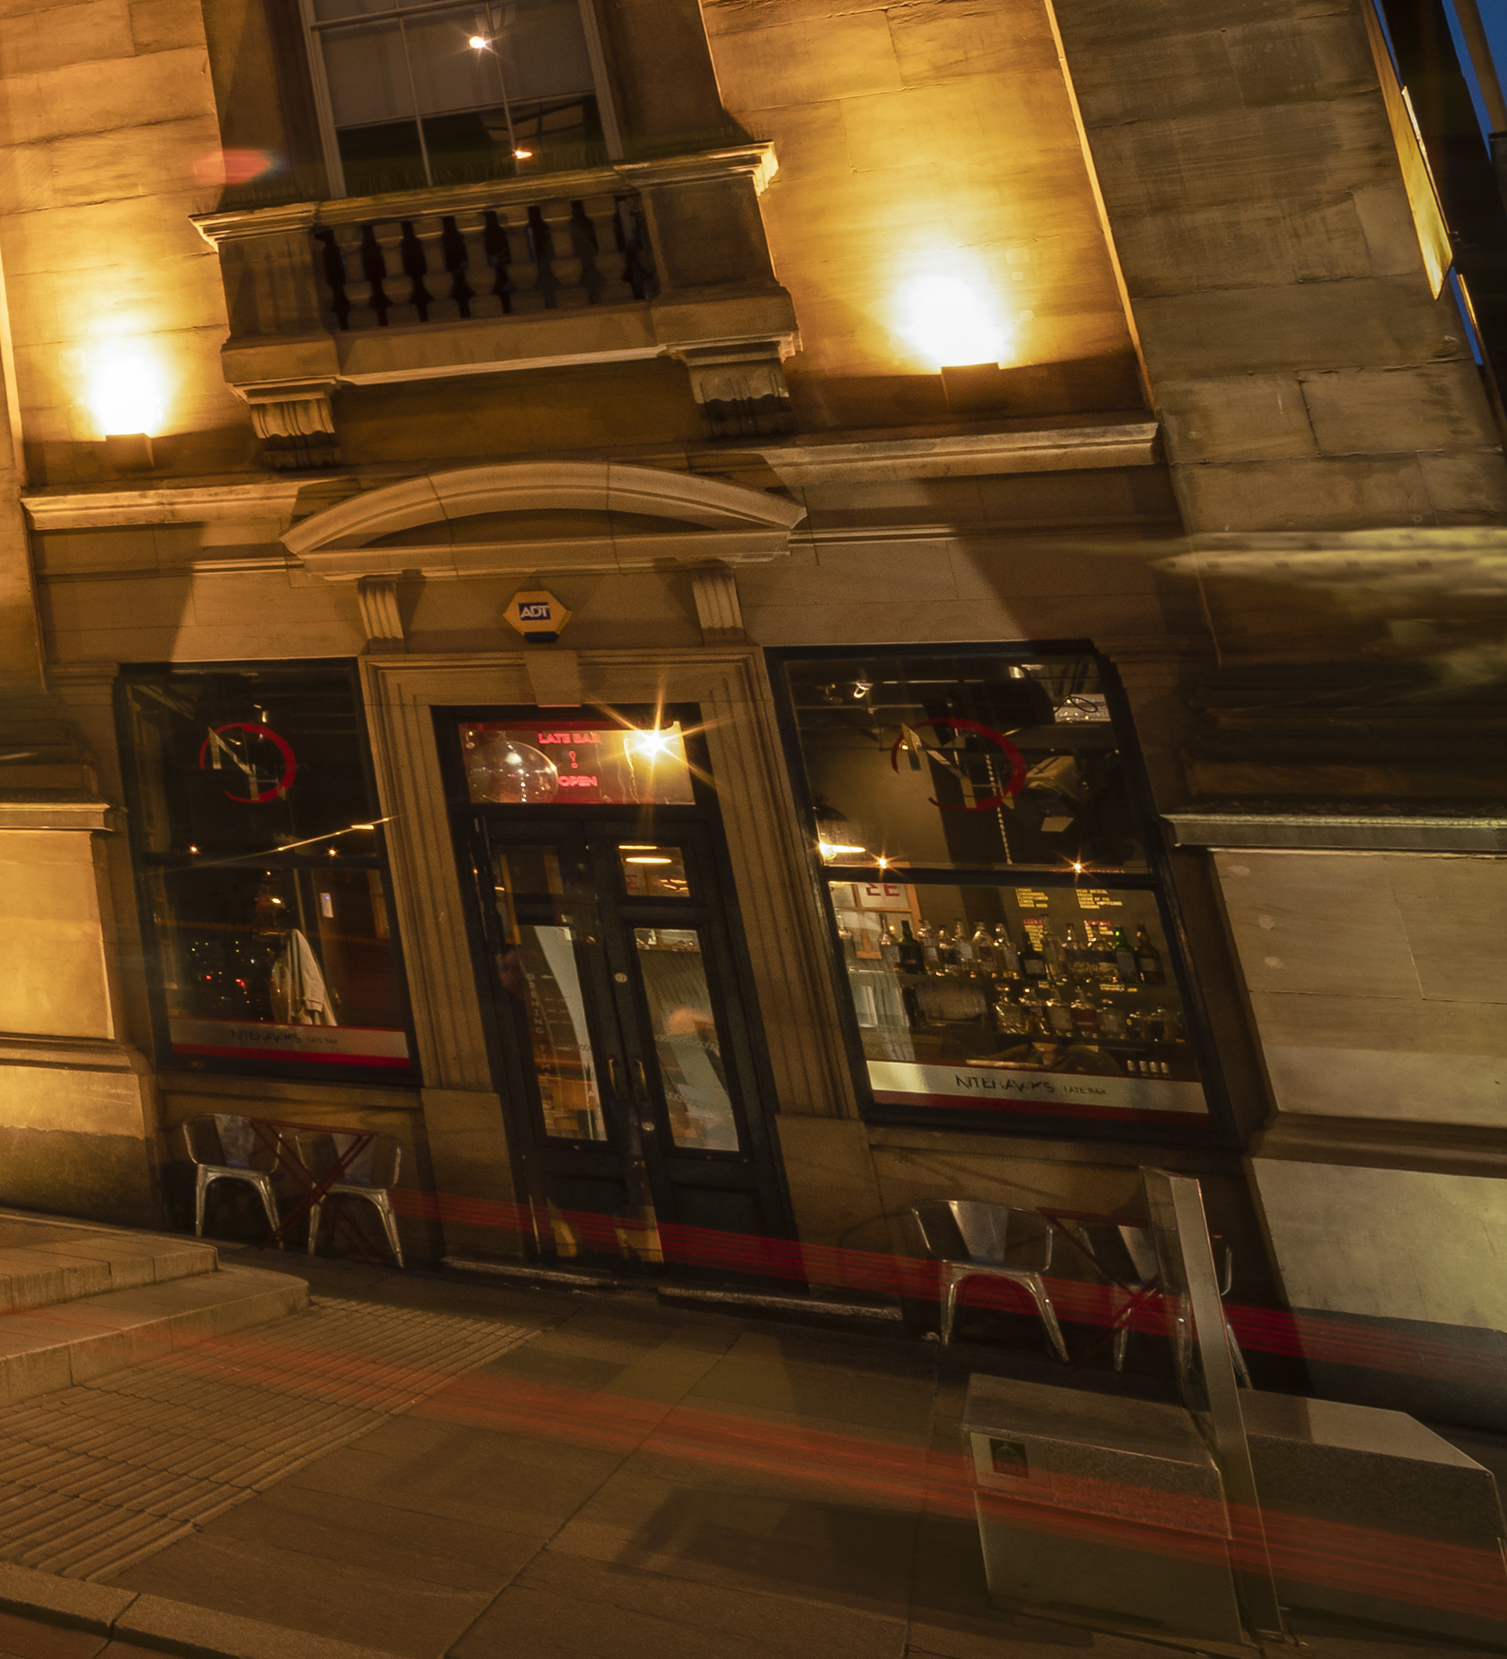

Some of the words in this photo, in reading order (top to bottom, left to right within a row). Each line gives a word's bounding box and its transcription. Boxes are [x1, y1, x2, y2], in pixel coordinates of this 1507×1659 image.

[520, 605, 550, 619] ADT
[538, 733, 571, 745] LATE
[573, 733, 602, 745] BAR
[558, 775, 598, 788] OPEN
[954, 1074, 1055, 1093] NITEHAWKS
